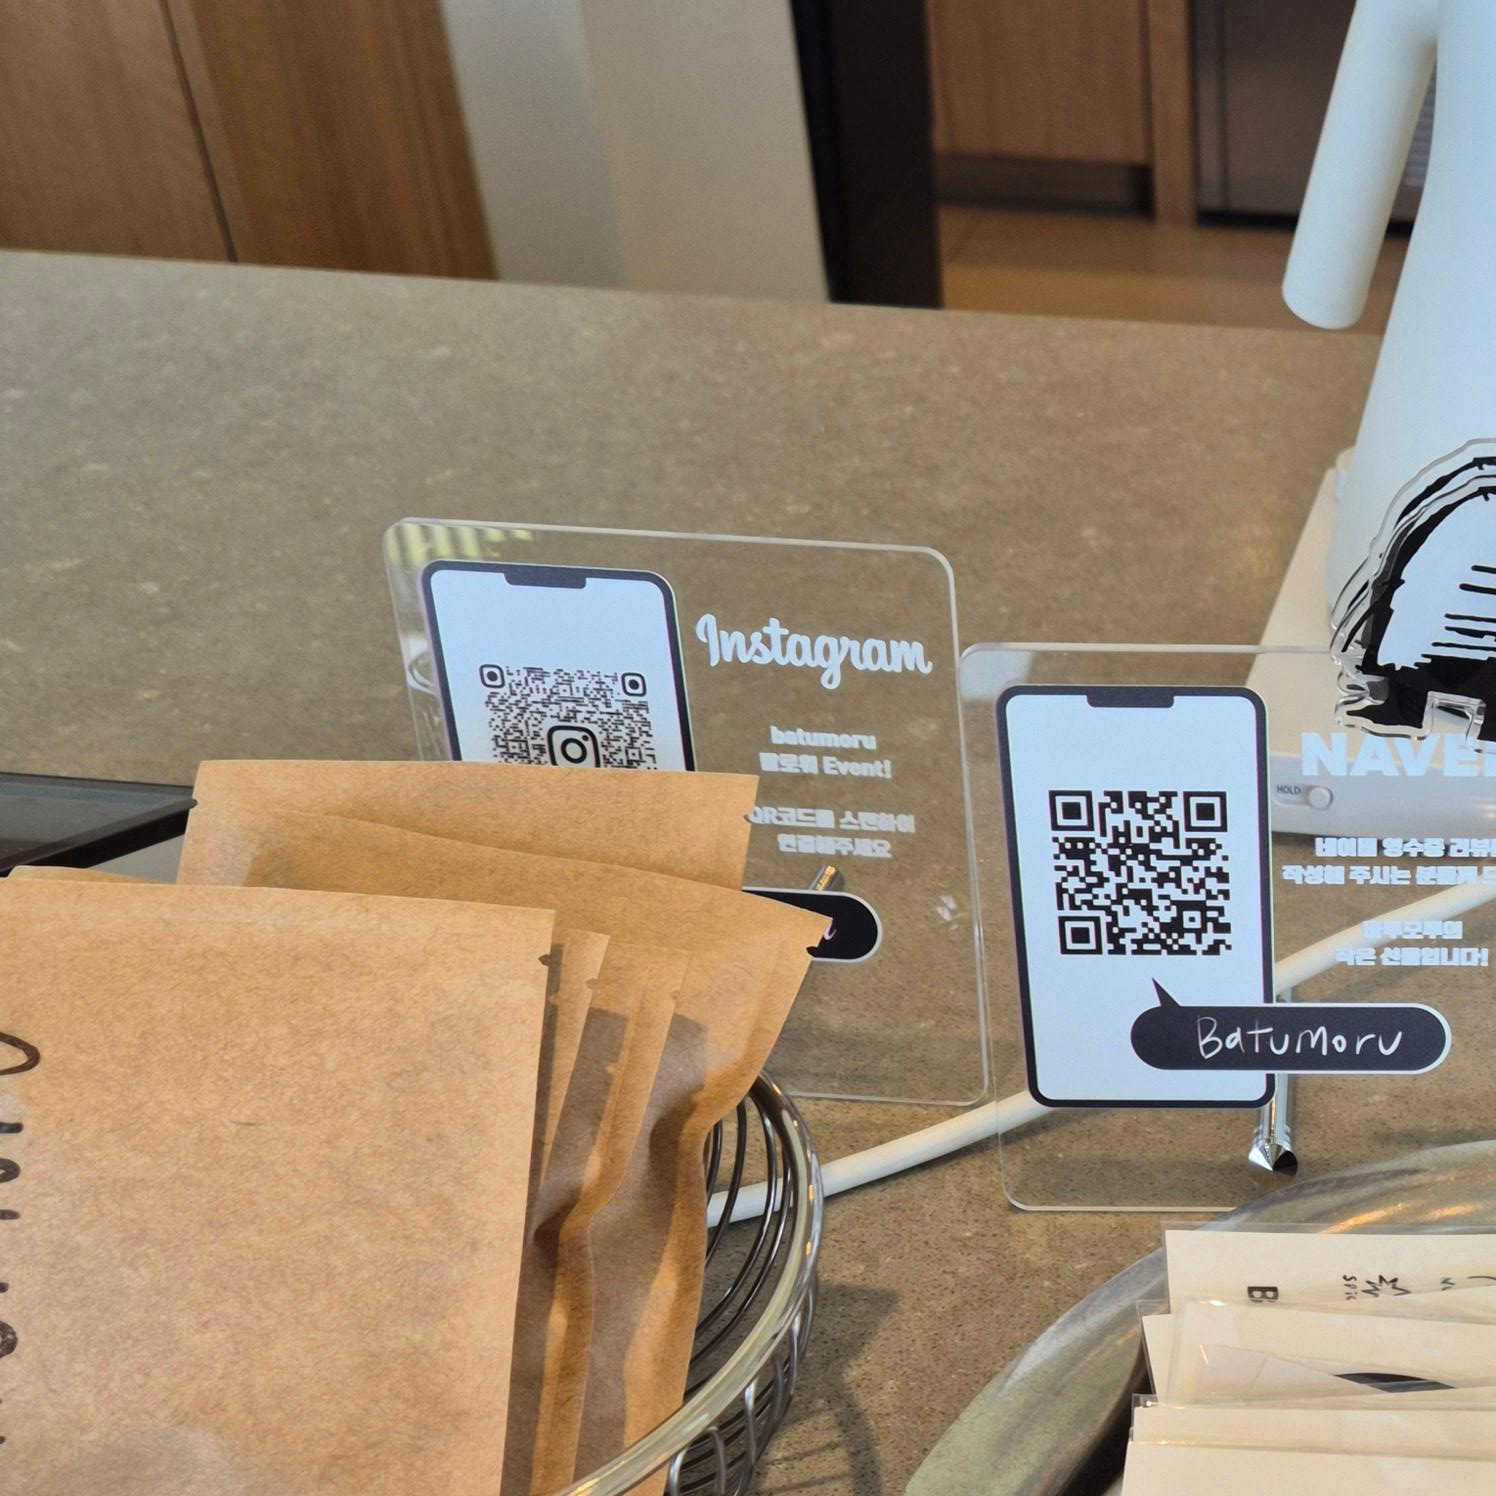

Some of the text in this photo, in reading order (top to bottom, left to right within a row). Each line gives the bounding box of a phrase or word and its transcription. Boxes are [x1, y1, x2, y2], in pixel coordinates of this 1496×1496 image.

[695, 613, 933, 690] Instagram
[769, 725, 877, 750] batumoru
[822, 755, 893, 779] Event!
[1276, 784, 1302, 796] HOLD
[1382, 837, 1446, 858] 영수증
[1348, 865, 1412, 885] 주시는
